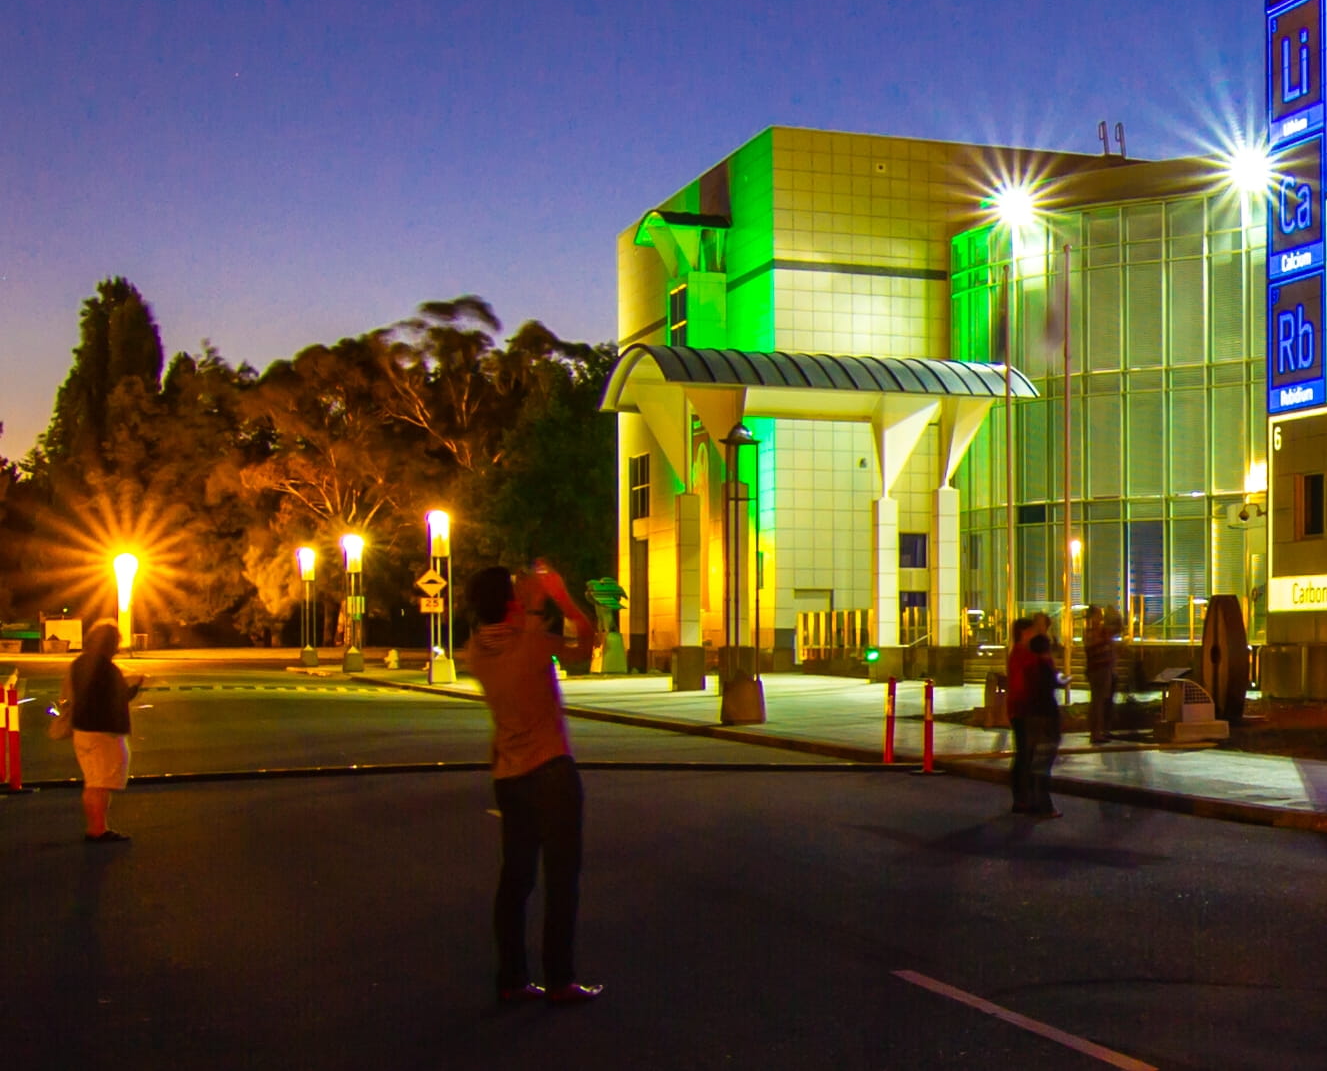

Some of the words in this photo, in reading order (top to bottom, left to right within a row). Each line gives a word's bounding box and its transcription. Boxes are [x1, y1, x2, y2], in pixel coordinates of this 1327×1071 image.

[1283, 31, 1308, 102] Li
[1279, 177, 1311, 234] Ca
[1281, 251, 1312, 273] Calcium
[1279, 305, 1313, 374] Rb
[1273, 427, 1281, 451] 6
[425, 599, 439, 607] 25
[1292, 584, 1327, 606] Carbon
